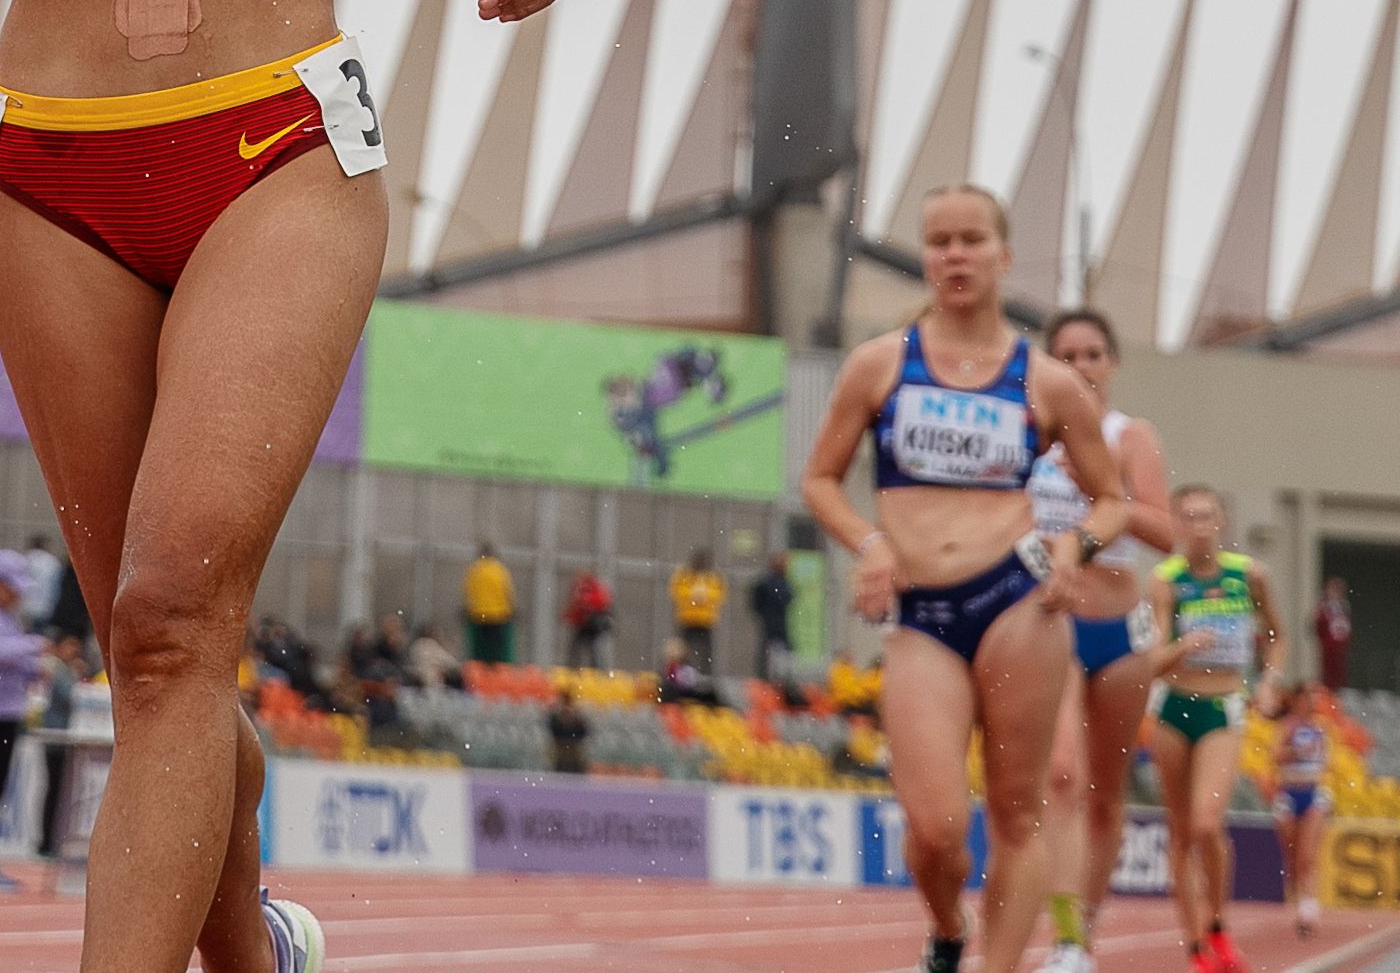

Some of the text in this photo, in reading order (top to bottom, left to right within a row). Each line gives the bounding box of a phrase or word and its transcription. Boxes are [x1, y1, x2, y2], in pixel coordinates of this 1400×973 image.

[338, 58, 382, 147] 3
[920, 394, 1001, 428] NTN
[741, 797, 835, 876] TBS
